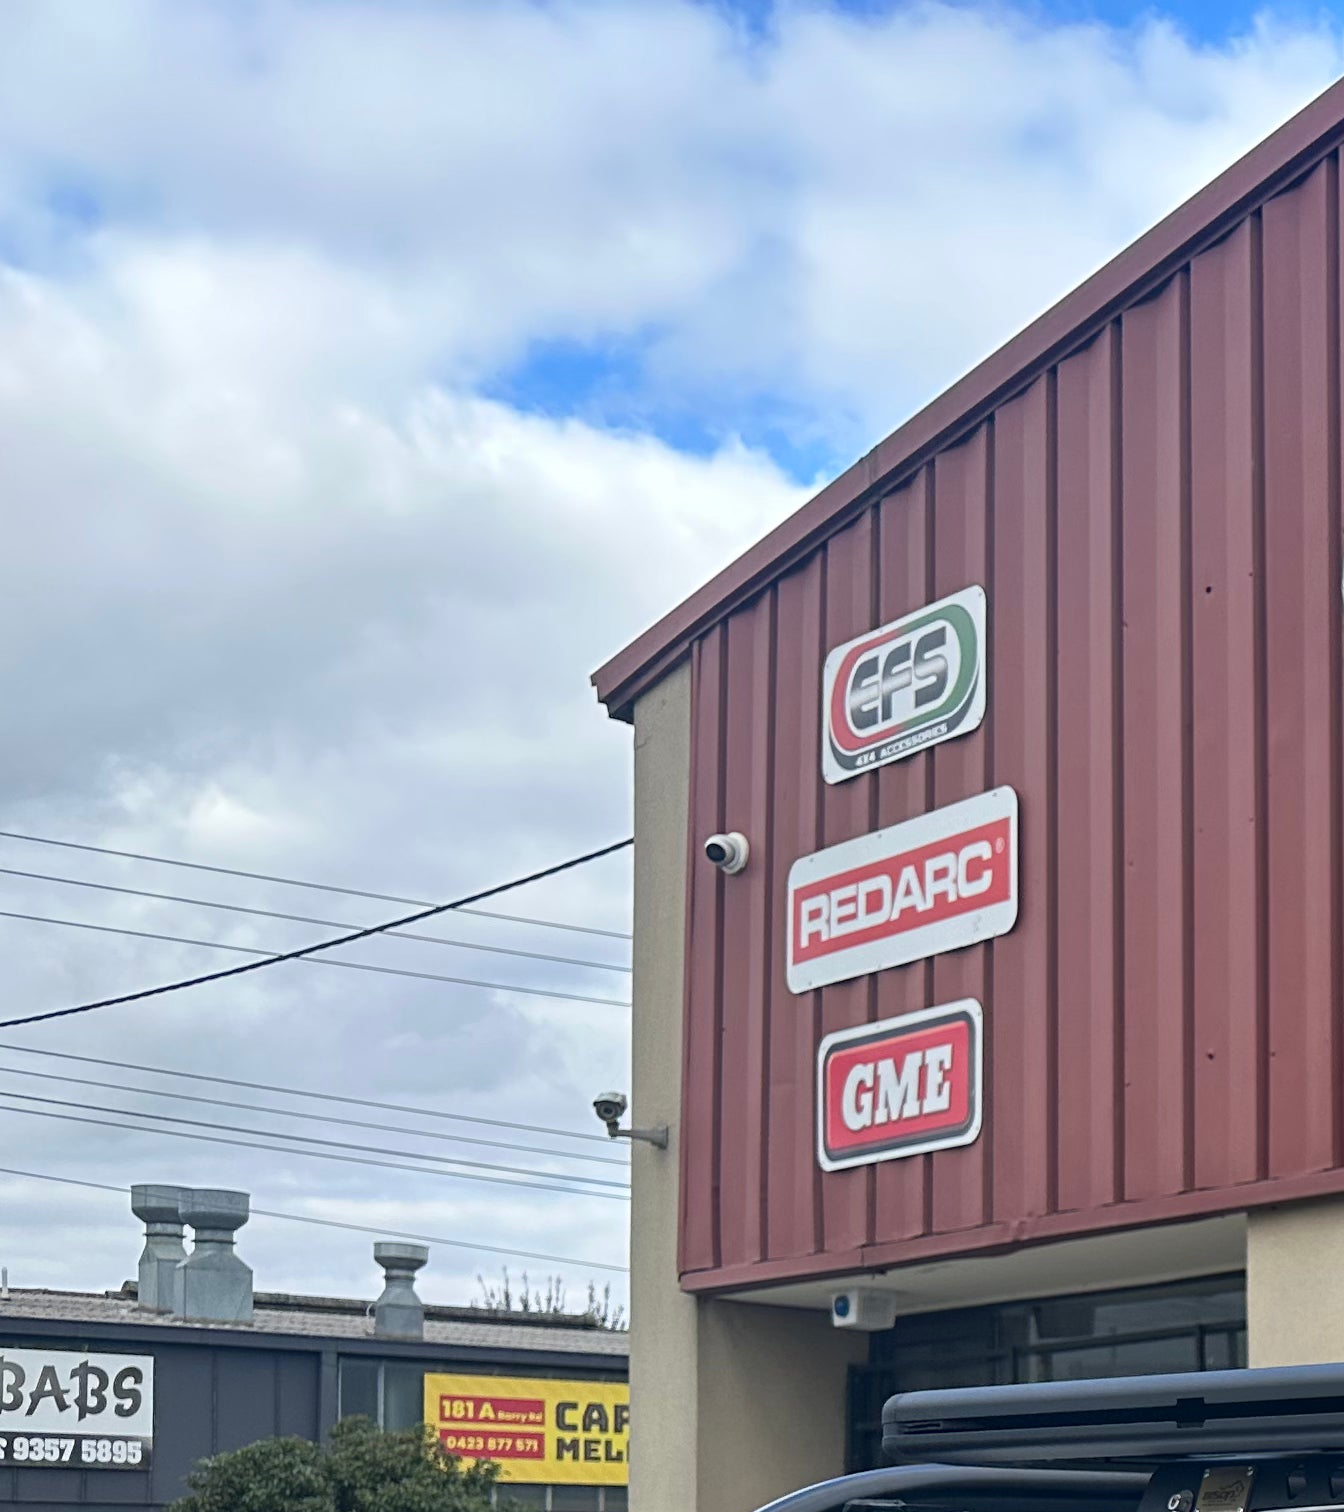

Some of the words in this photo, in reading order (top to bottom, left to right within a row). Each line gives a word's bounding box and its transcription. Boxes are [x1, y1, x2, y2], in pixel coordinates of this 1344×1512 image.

[850, 626, 949, 731] EFS
[800, 841, 993, 948] REDARC
[841, 1043, 954, 1131] GME
[442, 1399, 474, 1419] 181
[479, 1402, 495, 1419] A
[13, 1436, 75, 1461] 9357
[81, 1439, 143, 1464] 5895
[446, 1435, 484, 1450] 0423
[556, 1438, 630, 1462] MEL
